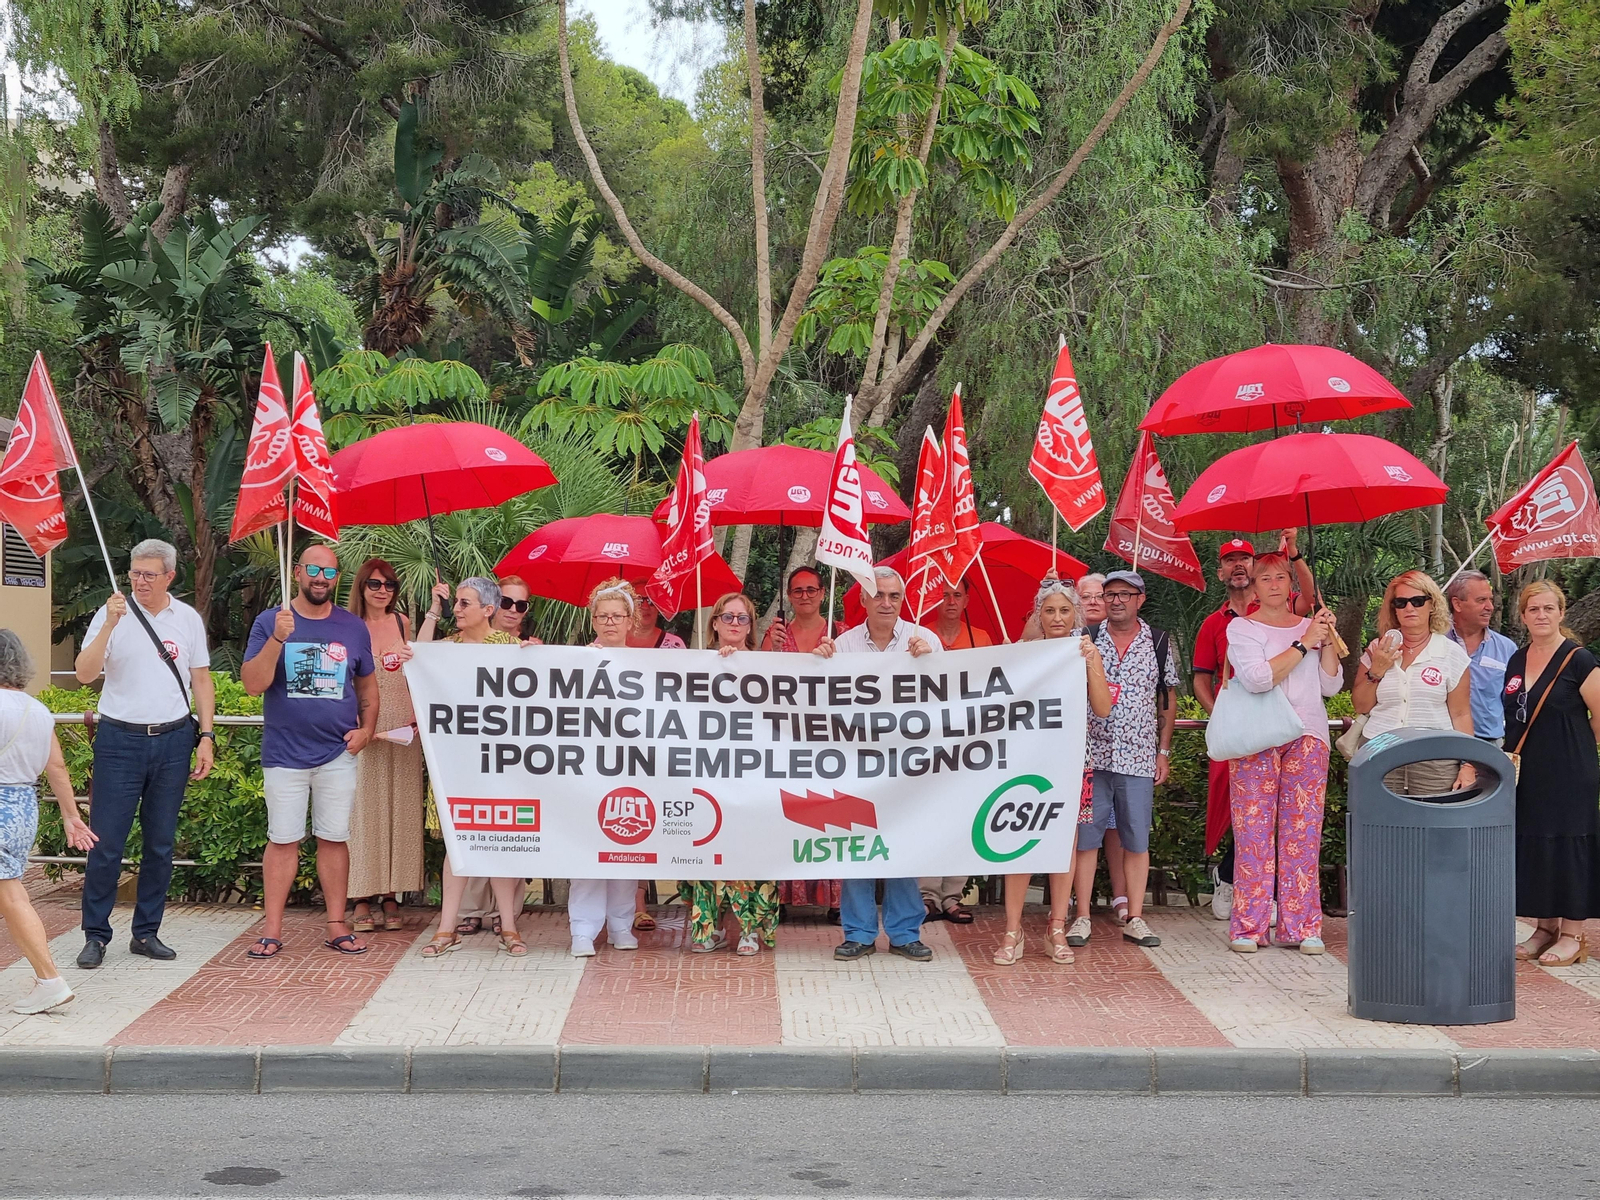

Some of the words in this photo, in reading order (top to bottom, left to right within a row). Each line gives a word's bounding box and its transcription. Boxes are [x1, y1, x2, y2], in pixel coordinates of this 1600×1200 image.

[1238, 383, 1264, 394] UGT
[707, 489, 729, 500] UGT
[790, 488, 808, 496] UGT
[602, 542, 630, 553] UGT
[1511, 532, 1598, 557] www.ugt.es
[476, 666, 538, 698] NO
[549, 660, 644, 700] MÁS
[655, 671, 881, 706] RECORTES
[892, 673, 948, 705] EN
[959, 666, 1014, 700] LA
[429, 703, 688, 739] RESIDENCIA
[698, 710, 753, 741] DE
[762, 709, 931, 742] TIEMPO
[941, 697, 1063, 739] LIBRE
[480, 743, 584, 776] ¡POR
[596, 745, 656, 777] UN
[667, 747, 847, 779] EMPLEO
[857, 738, 1007, 778] DIGNO!
[604, 796, 649, 820] UGT
[662, 801, 695, 818] FeSP
[990, 801, 1065, 832] CSIF
[662, 820, 693, 828] Servicios
[662, 827, 691, 836] Públicos
[489, 834, 540, 842] ciudadanía
[469, 844, 499, 852] almería
[501, 845, 540, 853] andalucía
[793, 834, 890, 863] USTEA
[608, 853, 645, 862] Andalucía
[671, 856, 703, 865] Almería
